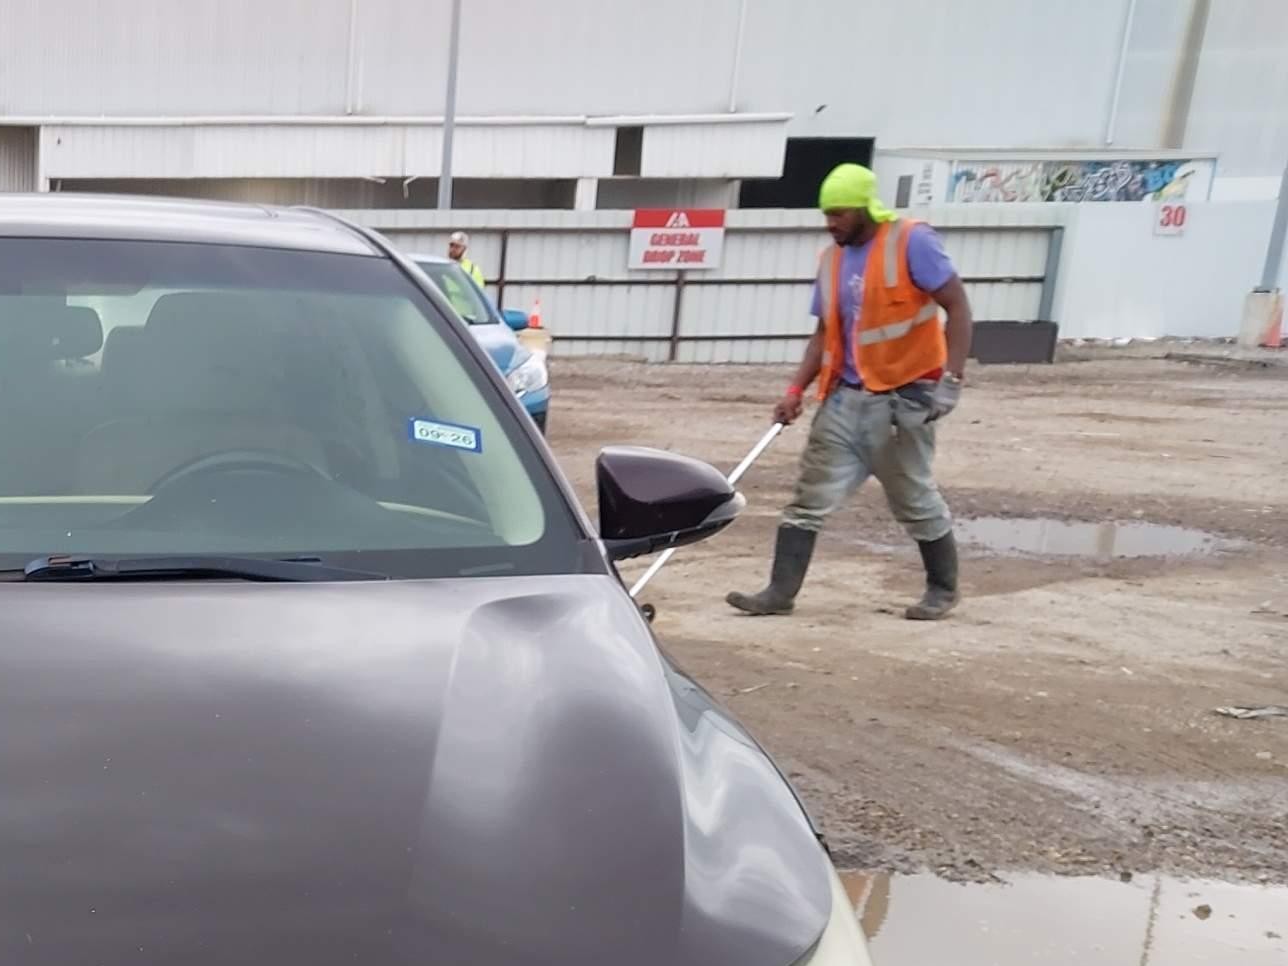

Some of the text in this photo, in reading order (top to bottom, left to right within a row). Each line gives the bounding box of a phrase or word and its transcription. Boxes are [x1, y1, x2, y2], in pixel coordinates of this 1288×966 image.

[1159, 205, 1187, 227] 30
[650, 233, 700, 246] GENERAL
[643, 250, 706, 263] DROP ZONE
